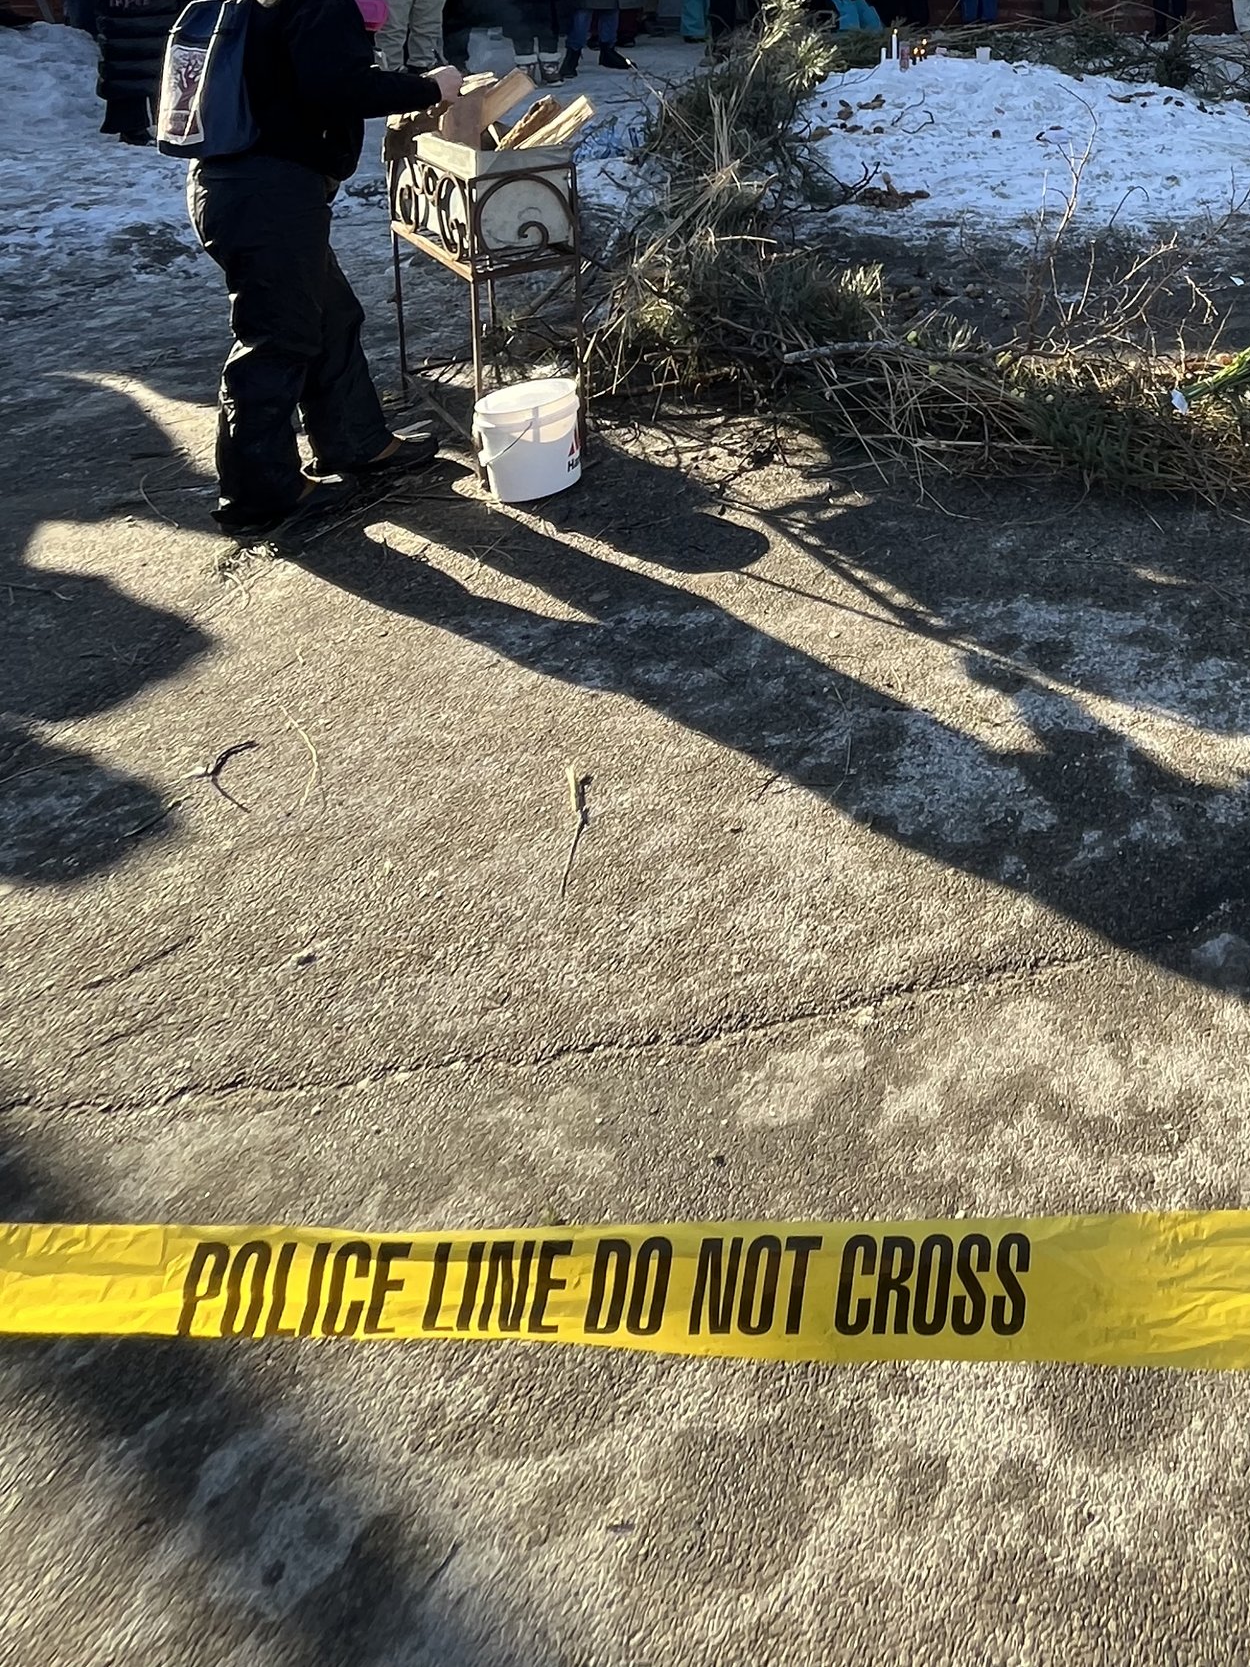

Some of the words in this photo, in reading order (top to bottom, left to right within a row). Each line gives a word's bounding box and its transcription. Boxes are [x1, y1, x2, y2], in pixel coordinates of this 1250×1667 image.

[178, 1240, 413, 1336] POLICE
[422, 1240, 574, 1334] LINE
[583, 1237, 673, 1335] DO
[688, 1235, 823, 1335] NOT
[834, 1232, 1031, 1335] CROSS
